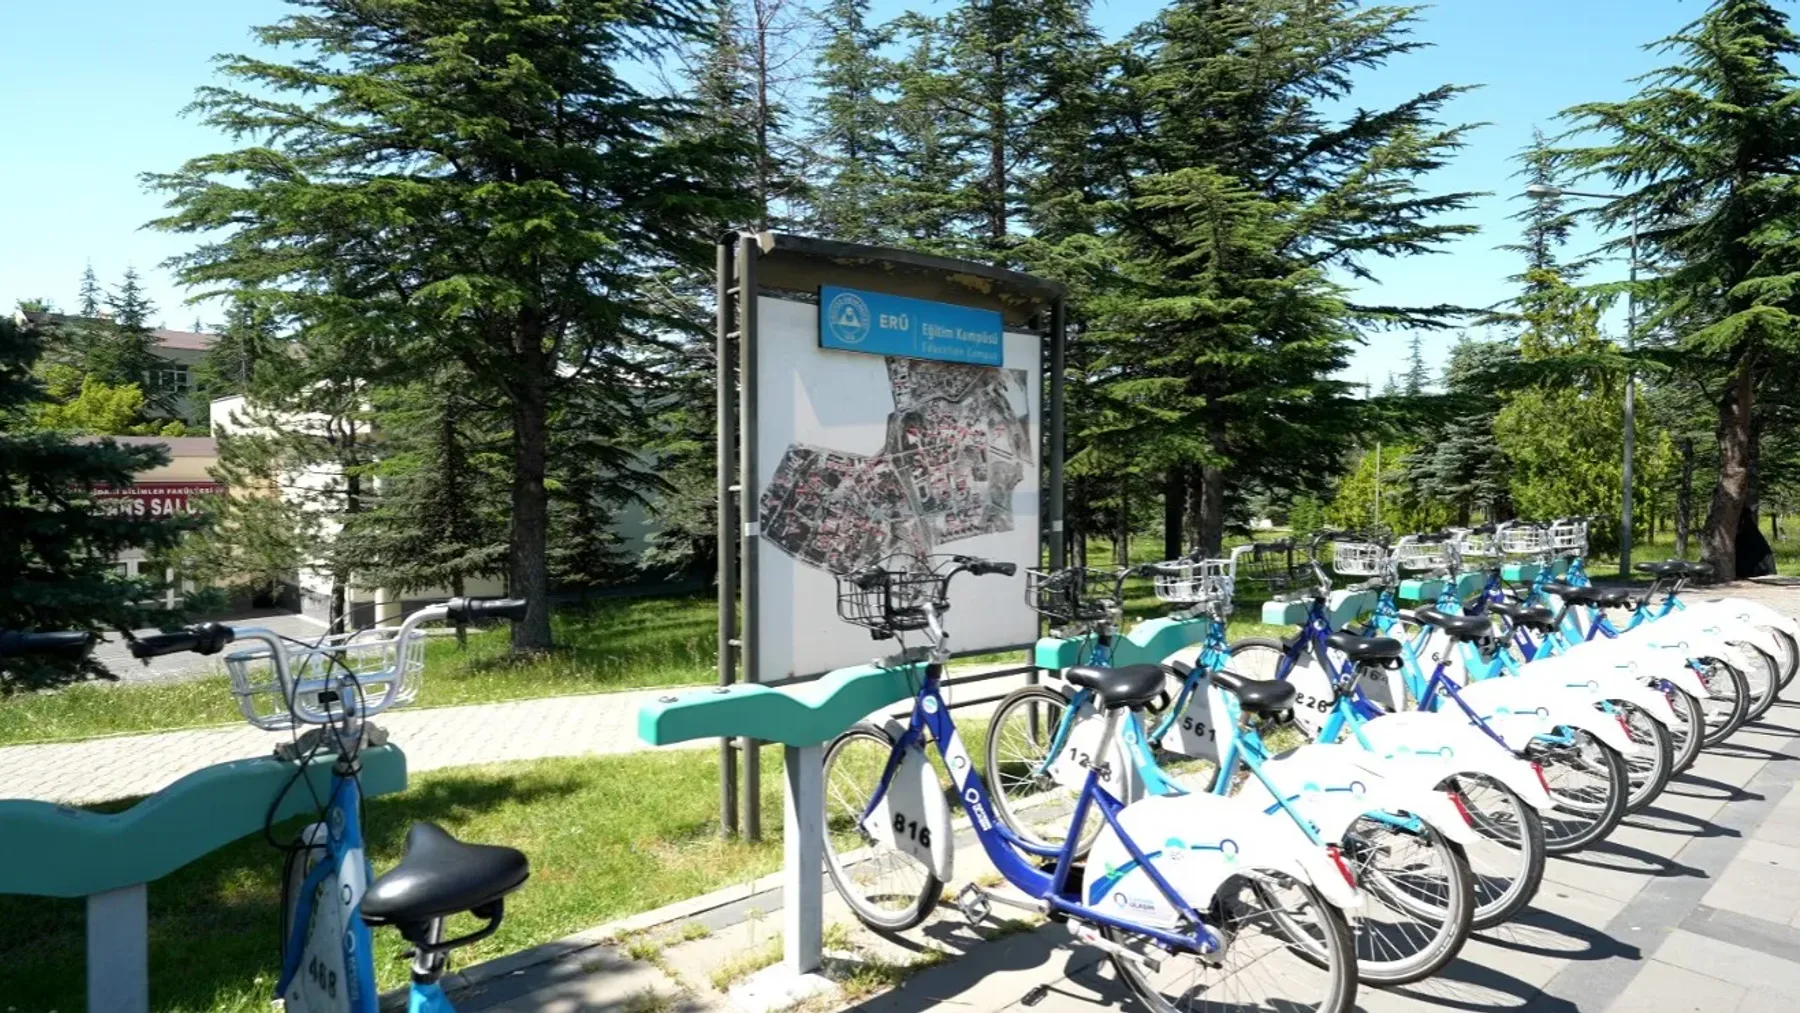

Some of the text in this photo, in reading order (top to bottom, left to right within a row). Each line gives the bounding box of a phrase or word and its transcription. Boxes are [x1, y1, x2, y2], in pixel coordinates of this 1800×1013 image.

[879, 313, 909, 331] ERÜ
[921, 323, 953, 340] Eğitim
[1182, 716, 1216, 742] 561
[893, 813, 931, 848] 816
